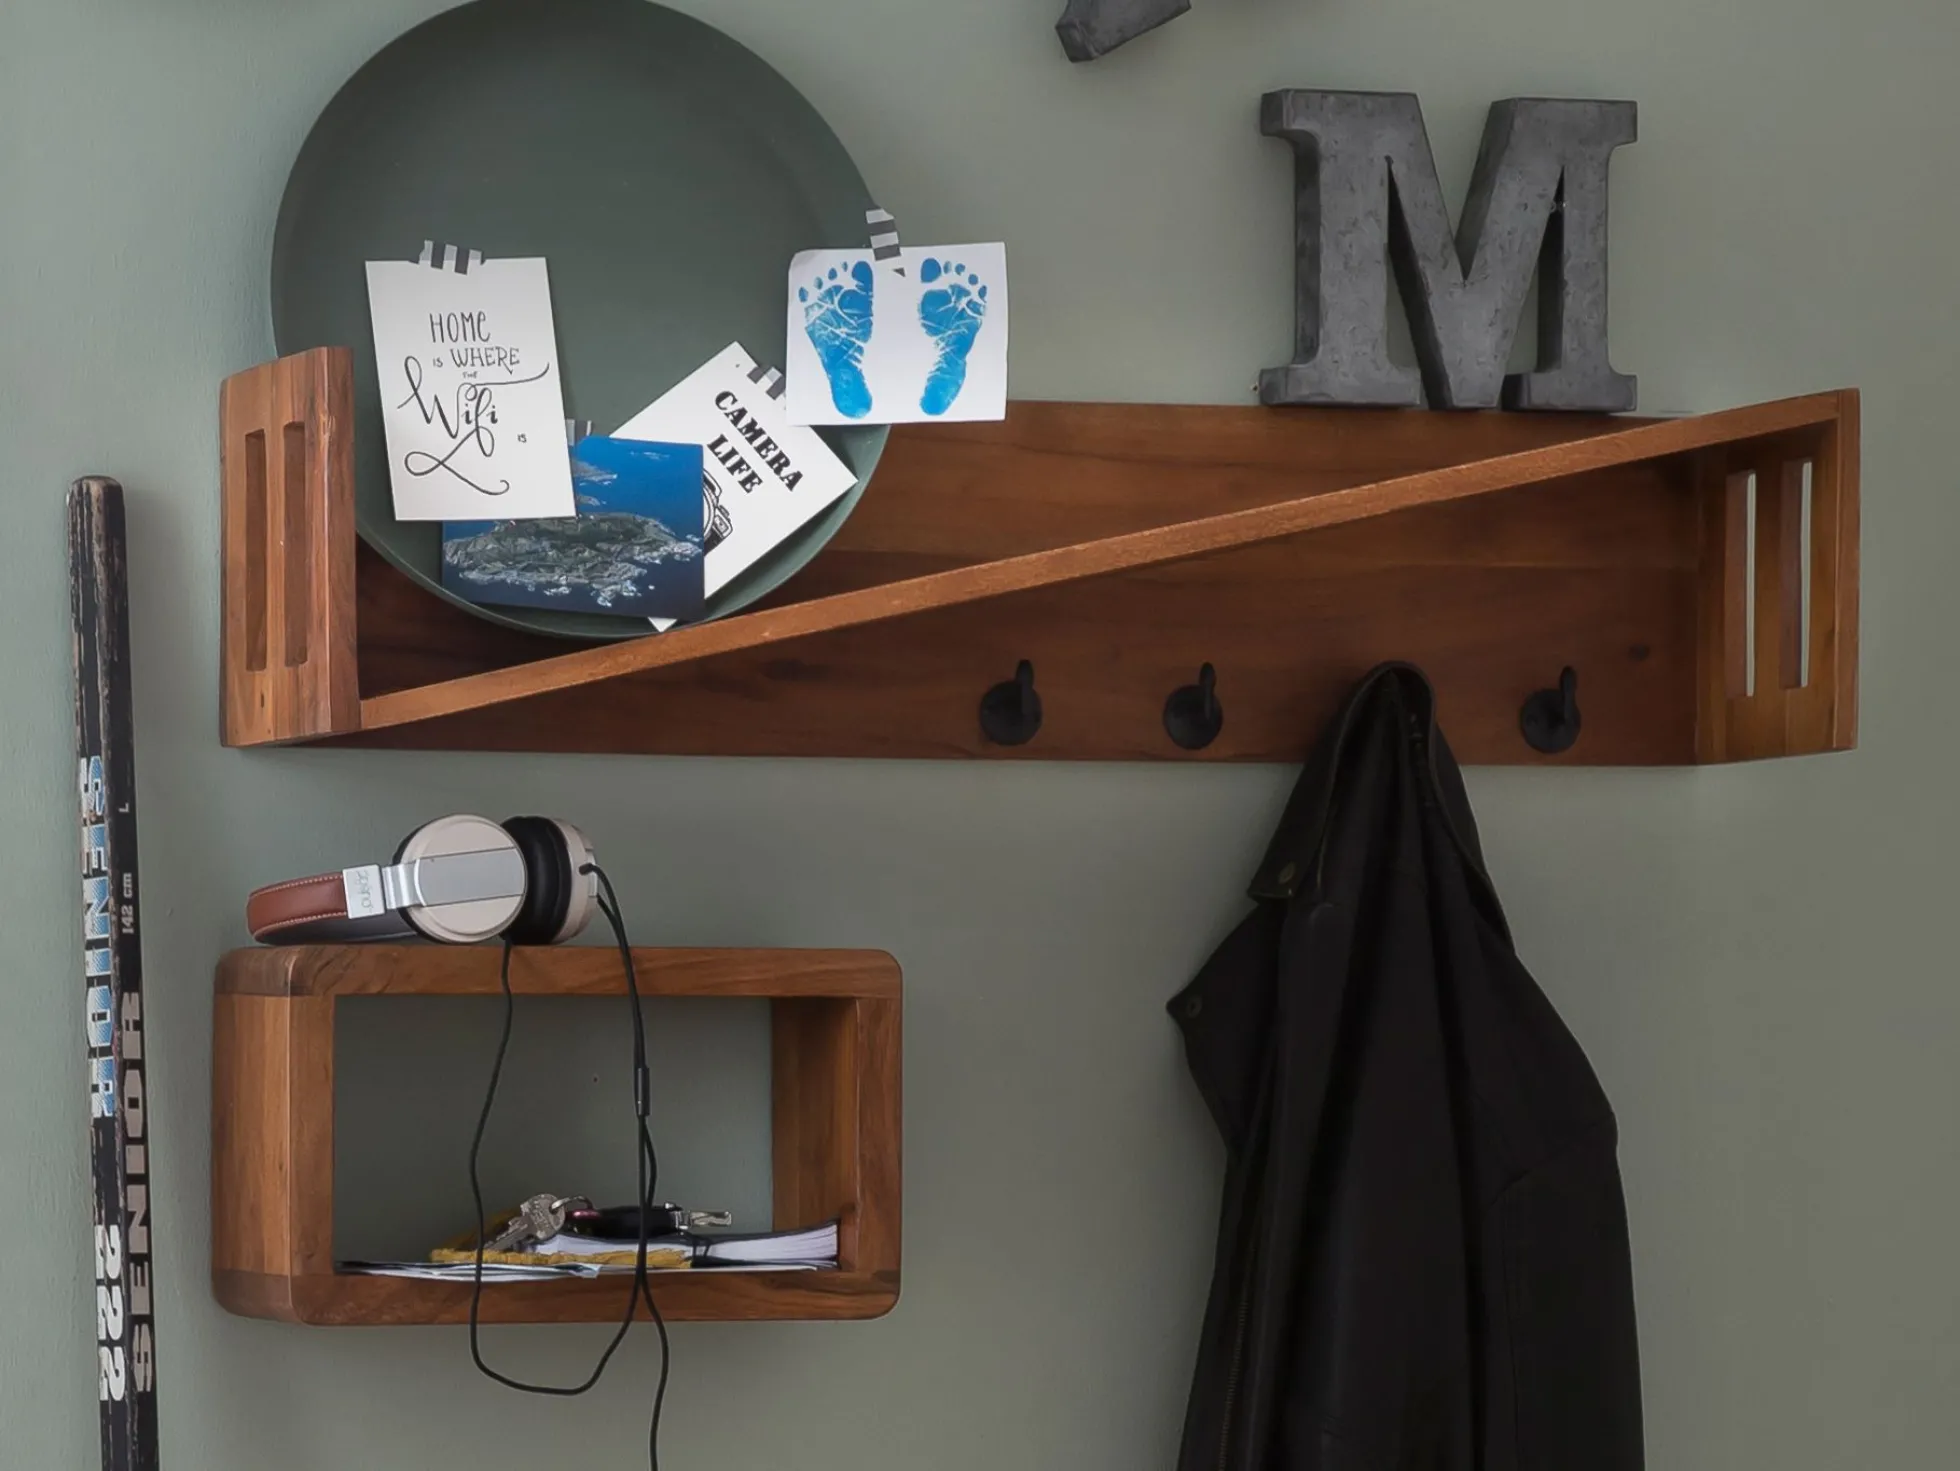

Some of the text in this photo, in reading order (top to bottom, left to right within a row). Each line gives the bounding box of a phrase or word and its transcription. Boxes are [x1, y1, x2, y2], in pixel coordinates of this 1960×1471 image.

[1260, 88, 1638, 412] M
[450, 346, 520, 375] WHERE
[707, 434, 763, 494] LIFE
[714, 390, 803, 492] CAMERA
[121, 904, 135, 935] 142
[123, 872, 133, 899] cm
[79, 755, 126, 1402] SENIOR 222
[121, 991, 153, 1392] SENIOR
